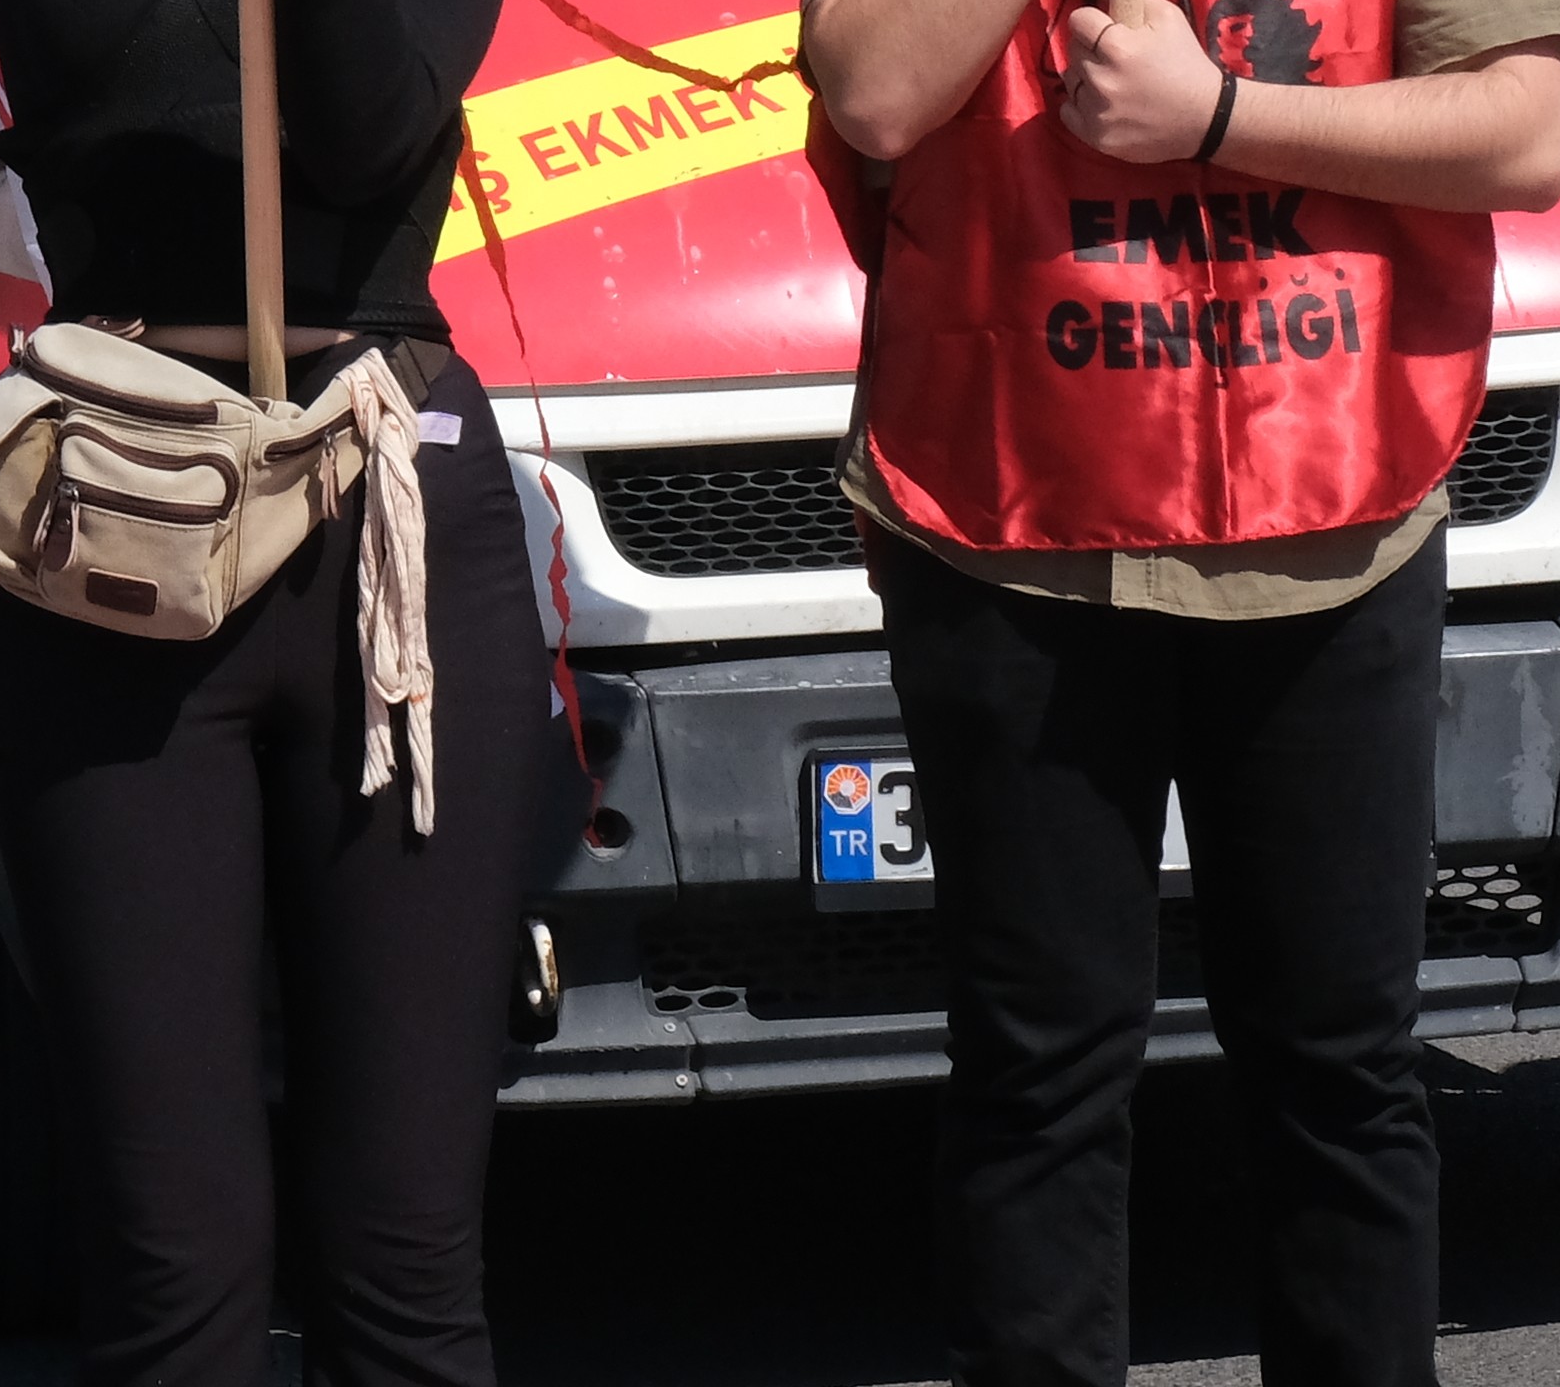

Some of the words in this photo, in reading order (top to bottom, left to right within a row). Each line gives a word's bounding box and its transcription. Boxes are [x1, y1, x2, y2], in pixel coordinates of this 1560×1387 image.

[519, 73, 786, 181] EKMEK
[1068, 190, 1317, 264] EMEK
[1046, 267, 1362, 387] GENÇLİĞİ
[829, 830, 868, 856] TR
[878, 771, 926, 865] 3
